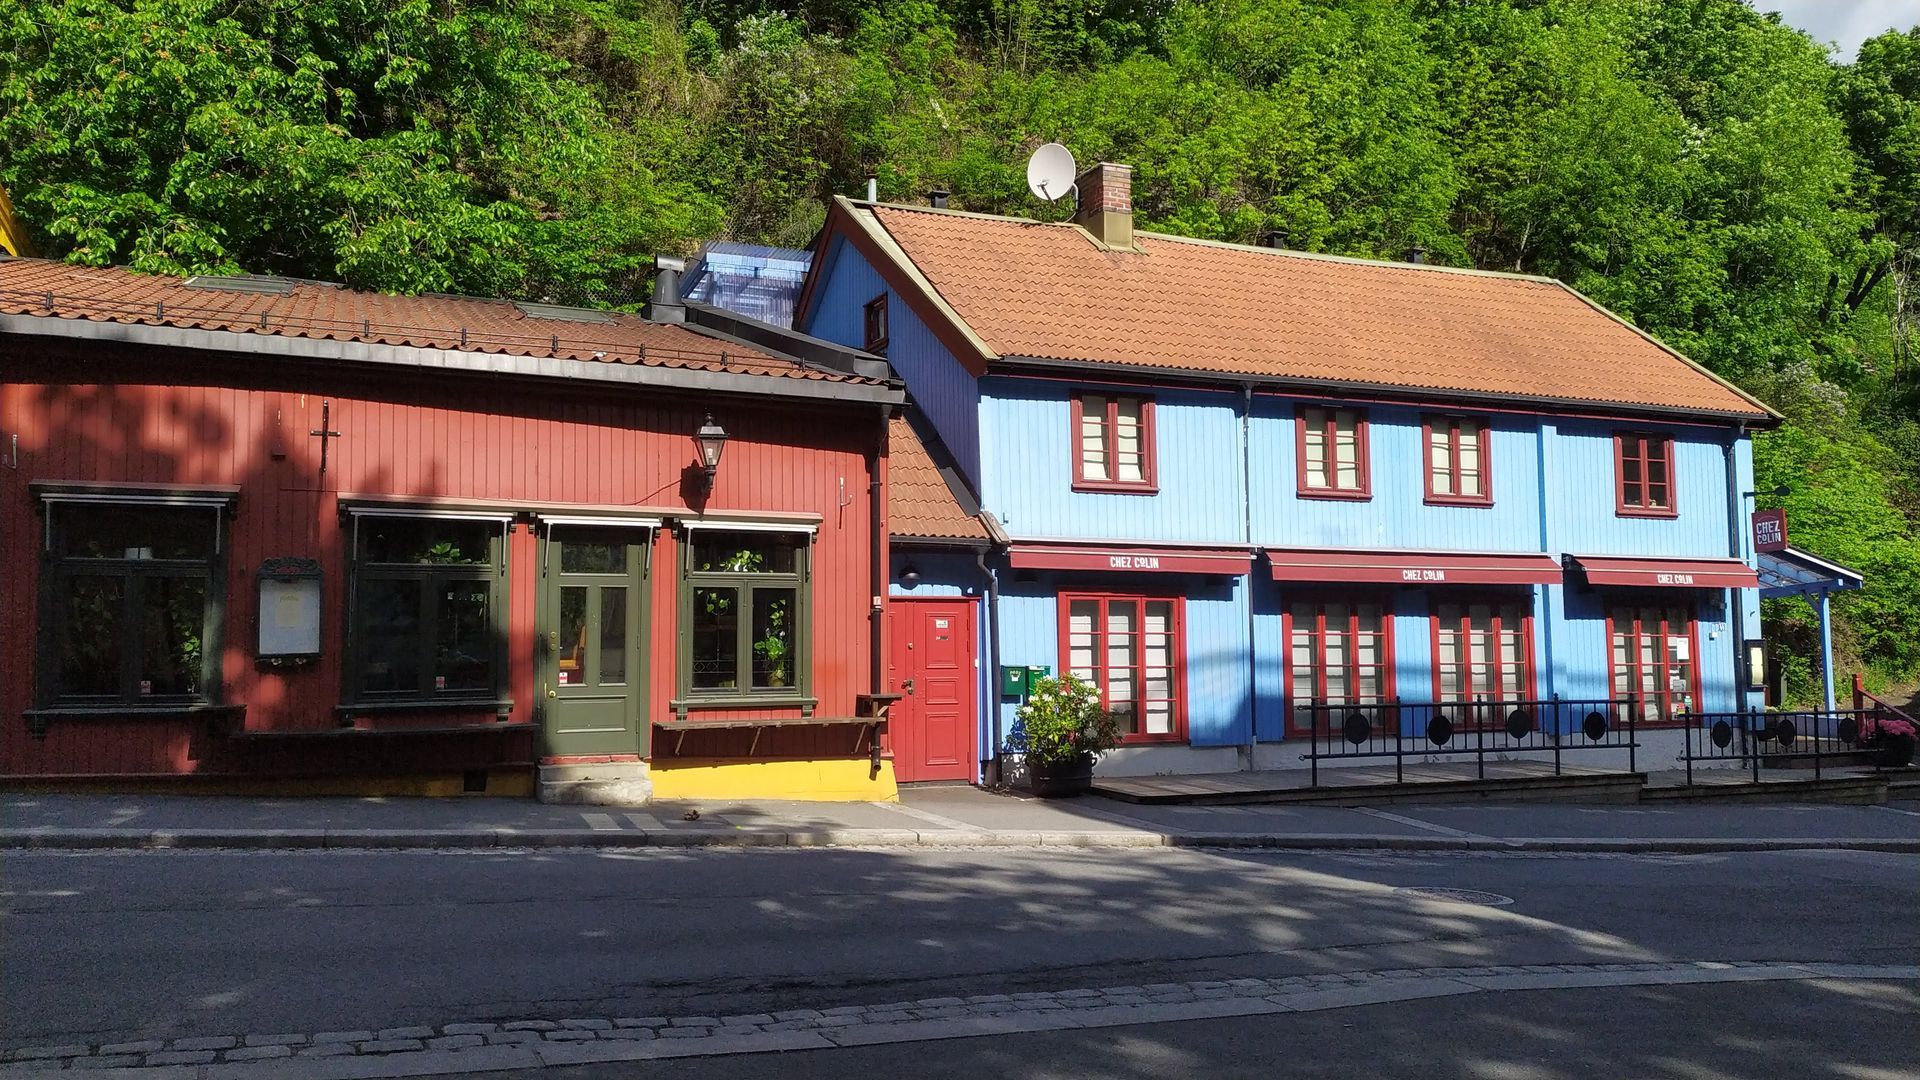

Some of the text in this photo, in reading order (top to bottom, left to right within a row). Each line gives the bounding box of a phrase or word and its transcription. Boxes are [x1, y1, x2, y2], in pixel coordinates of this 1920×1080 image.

[1756, 520, 1780, 534] CHEZ
[1110, 556, 1132, 568] CHEZ
[1403, 569, 1422, 581] CHEZ
[1657, 574, 1674, 584] CHEZ
